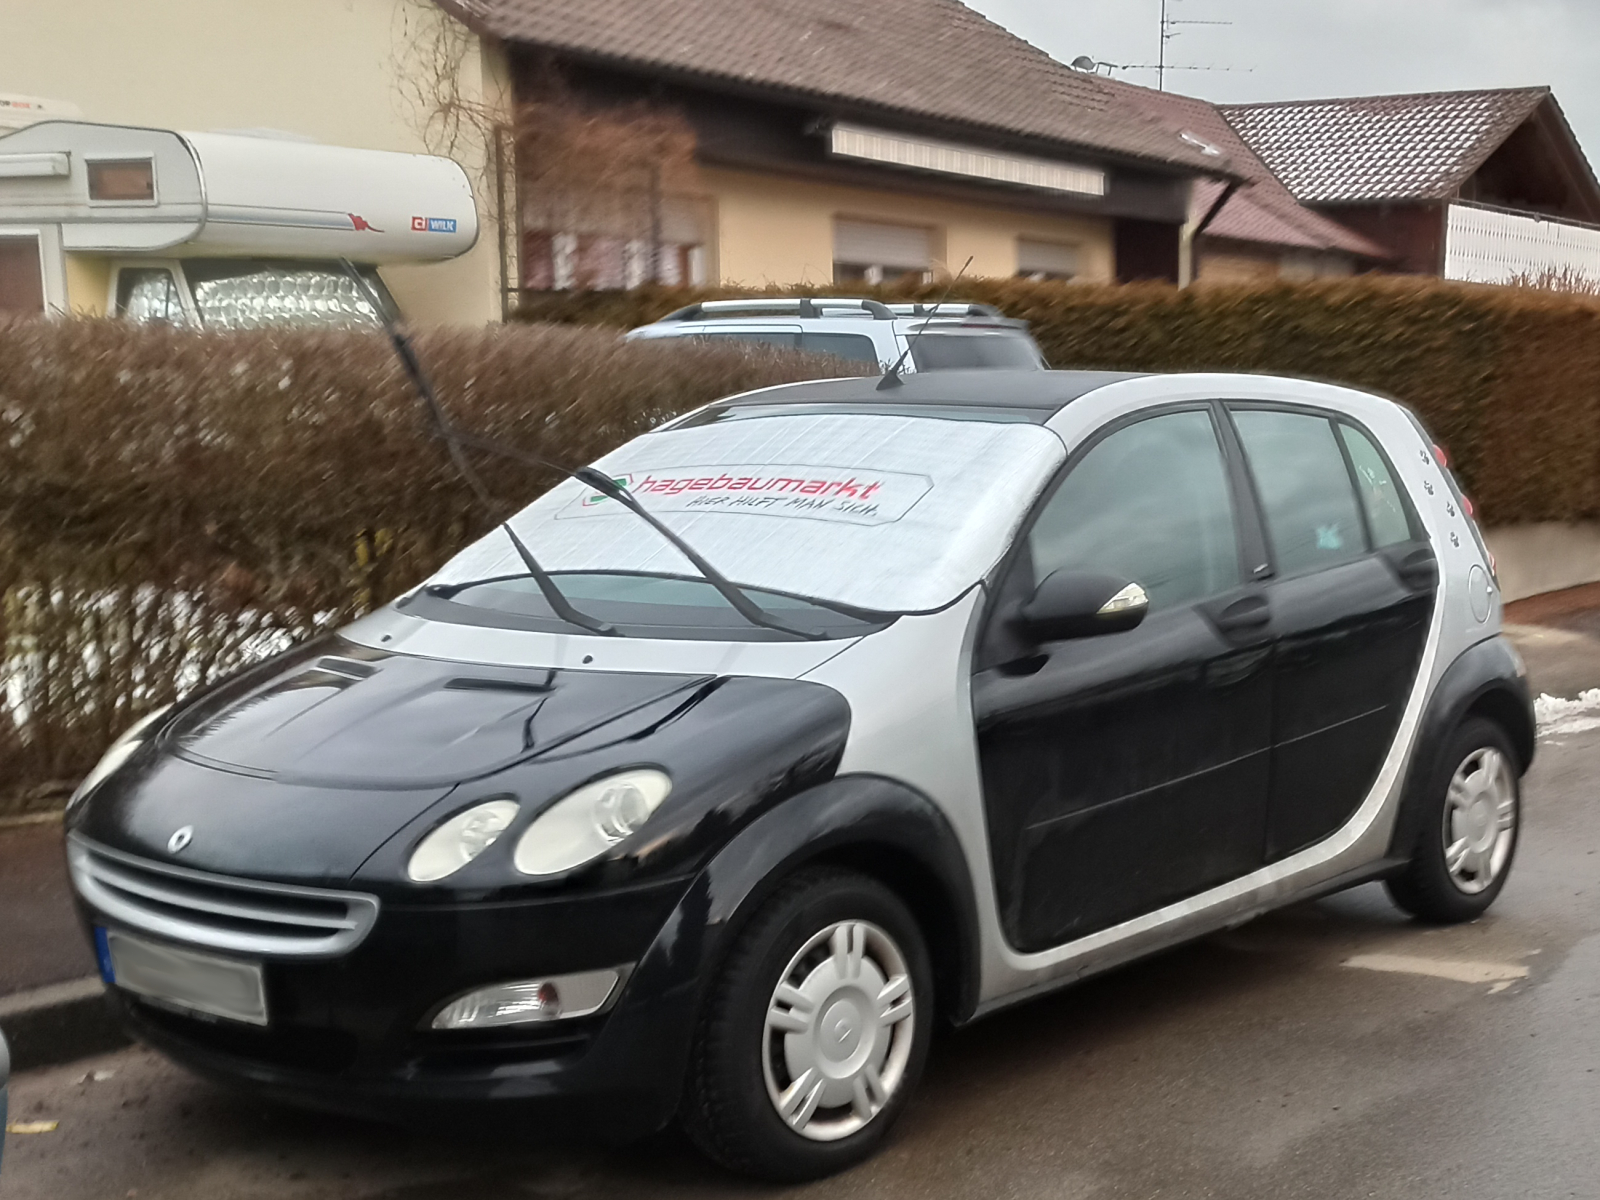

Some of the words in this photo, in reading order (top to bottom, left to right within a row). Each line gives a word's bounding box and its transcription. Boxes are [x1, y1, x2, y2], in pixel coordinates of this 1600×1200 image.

[430, 219, 454, 231] WILK
[632, 474, 882, 500] hagebaumarkt
[686, 495, 730, 508] HIER
[728, 496, 788, 509] HILFT
[784, 497, 836, 511] MAN
